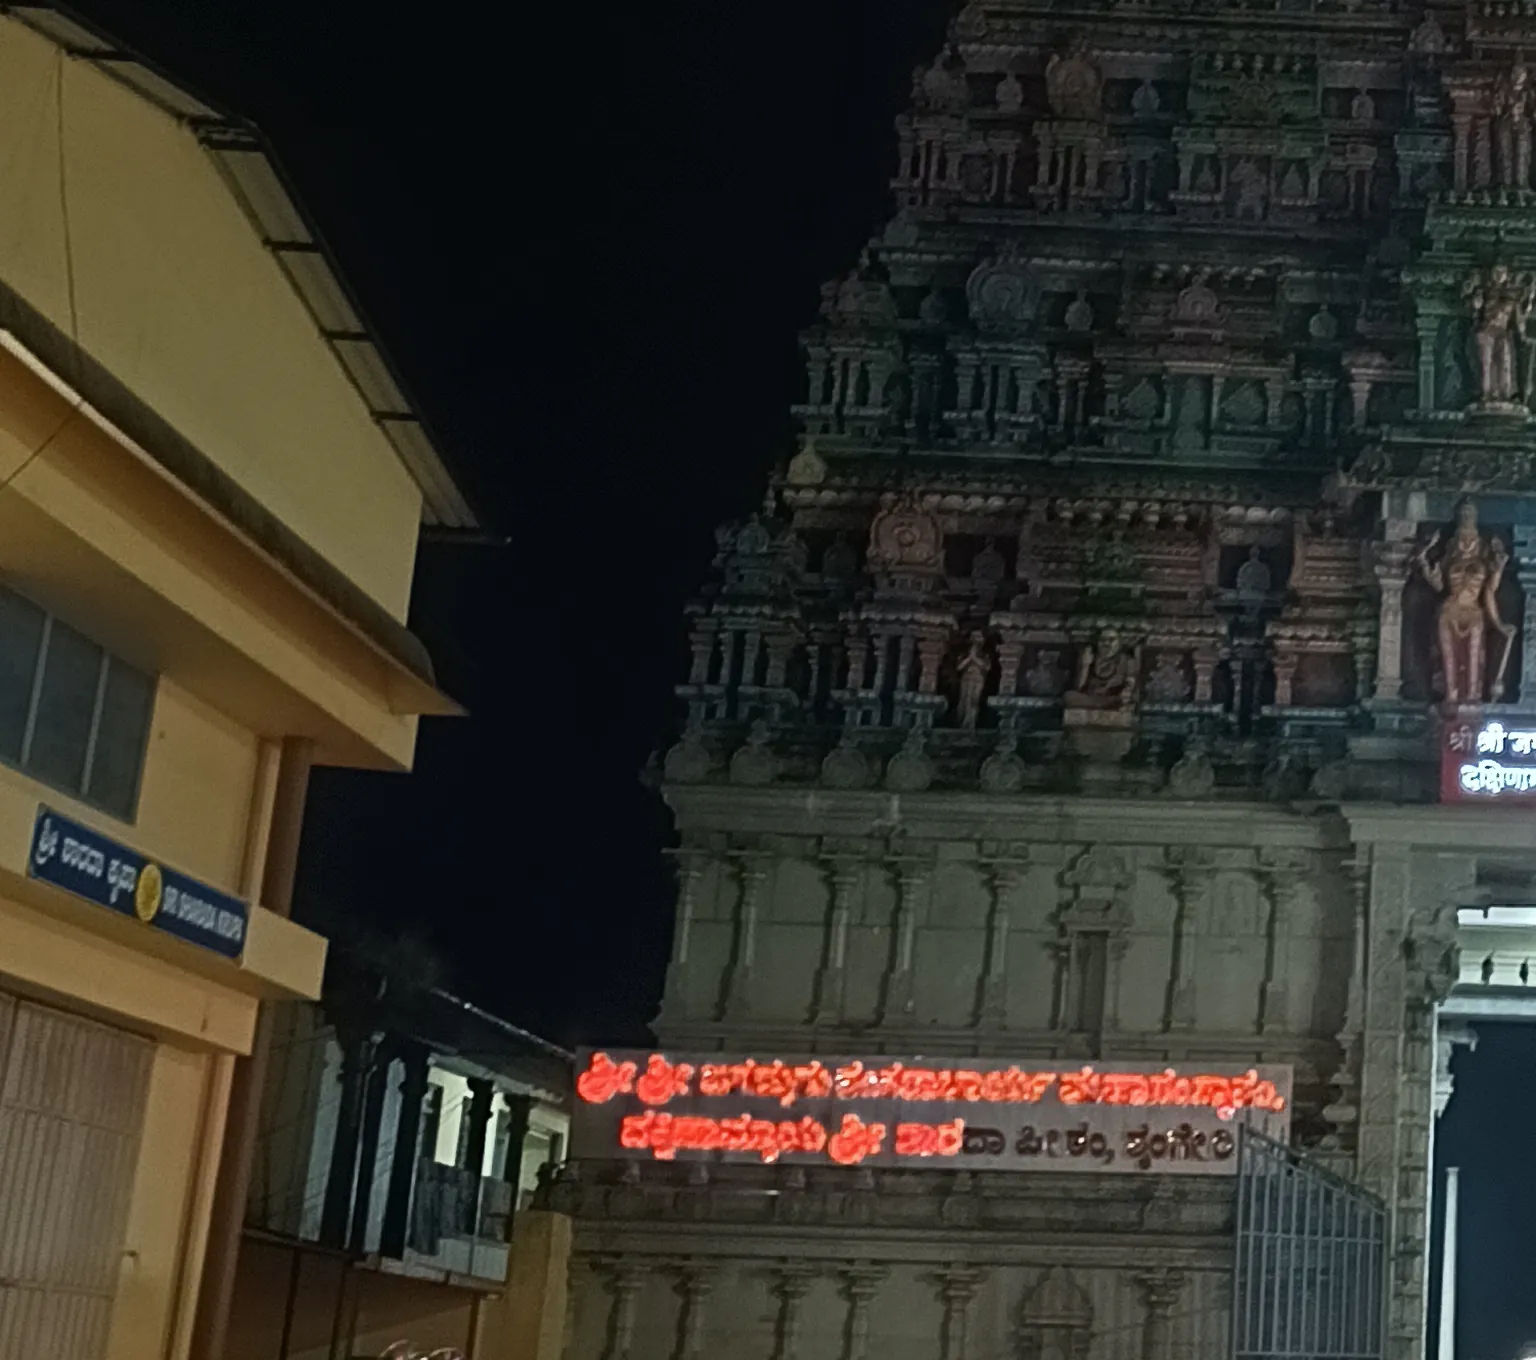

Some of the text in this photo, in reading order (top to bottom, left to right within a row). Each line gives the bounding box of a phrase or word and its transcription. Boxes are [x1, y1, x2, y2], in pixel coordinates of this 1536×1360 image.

[1477, 722, 1507, 754] श्री
[577, 1052, 637, 1104] ಶ್ರೀ
[637, 1053, 694, 1106] ಶ್ರೀ
[828, 1113, 887, 1165] ಶ್ರೀ
[895, 1117, 1006, 1157] ಶಾರದಾ
